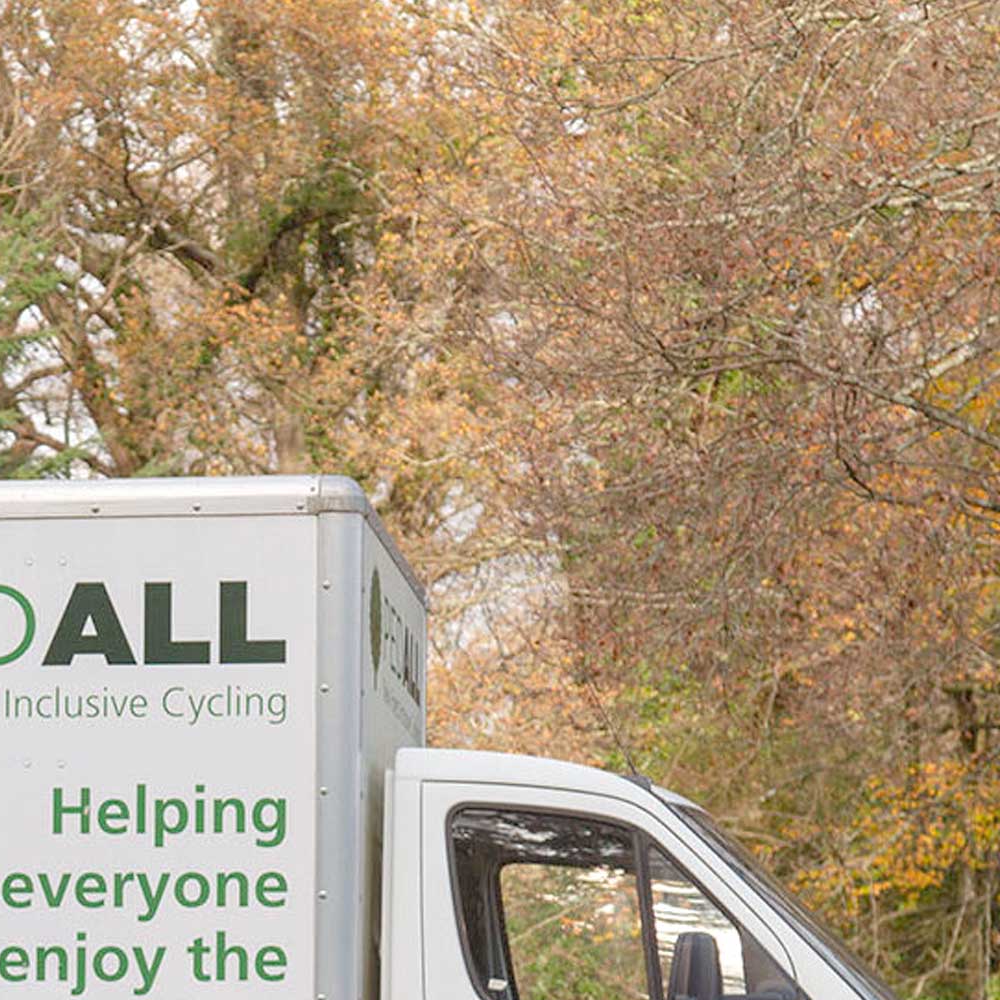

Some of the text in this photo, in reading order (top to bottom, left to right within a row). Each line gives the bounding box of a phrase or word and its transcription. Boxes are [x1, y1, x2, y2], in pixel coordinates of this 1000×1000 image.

[4, 687, 147, 719] Inclusive
[162, 685, 288, 726] Cycling
[52, 784, 287, 847] Helping
[1, 871, 288, 922] everyone
[187, 930, 288, 981] the
